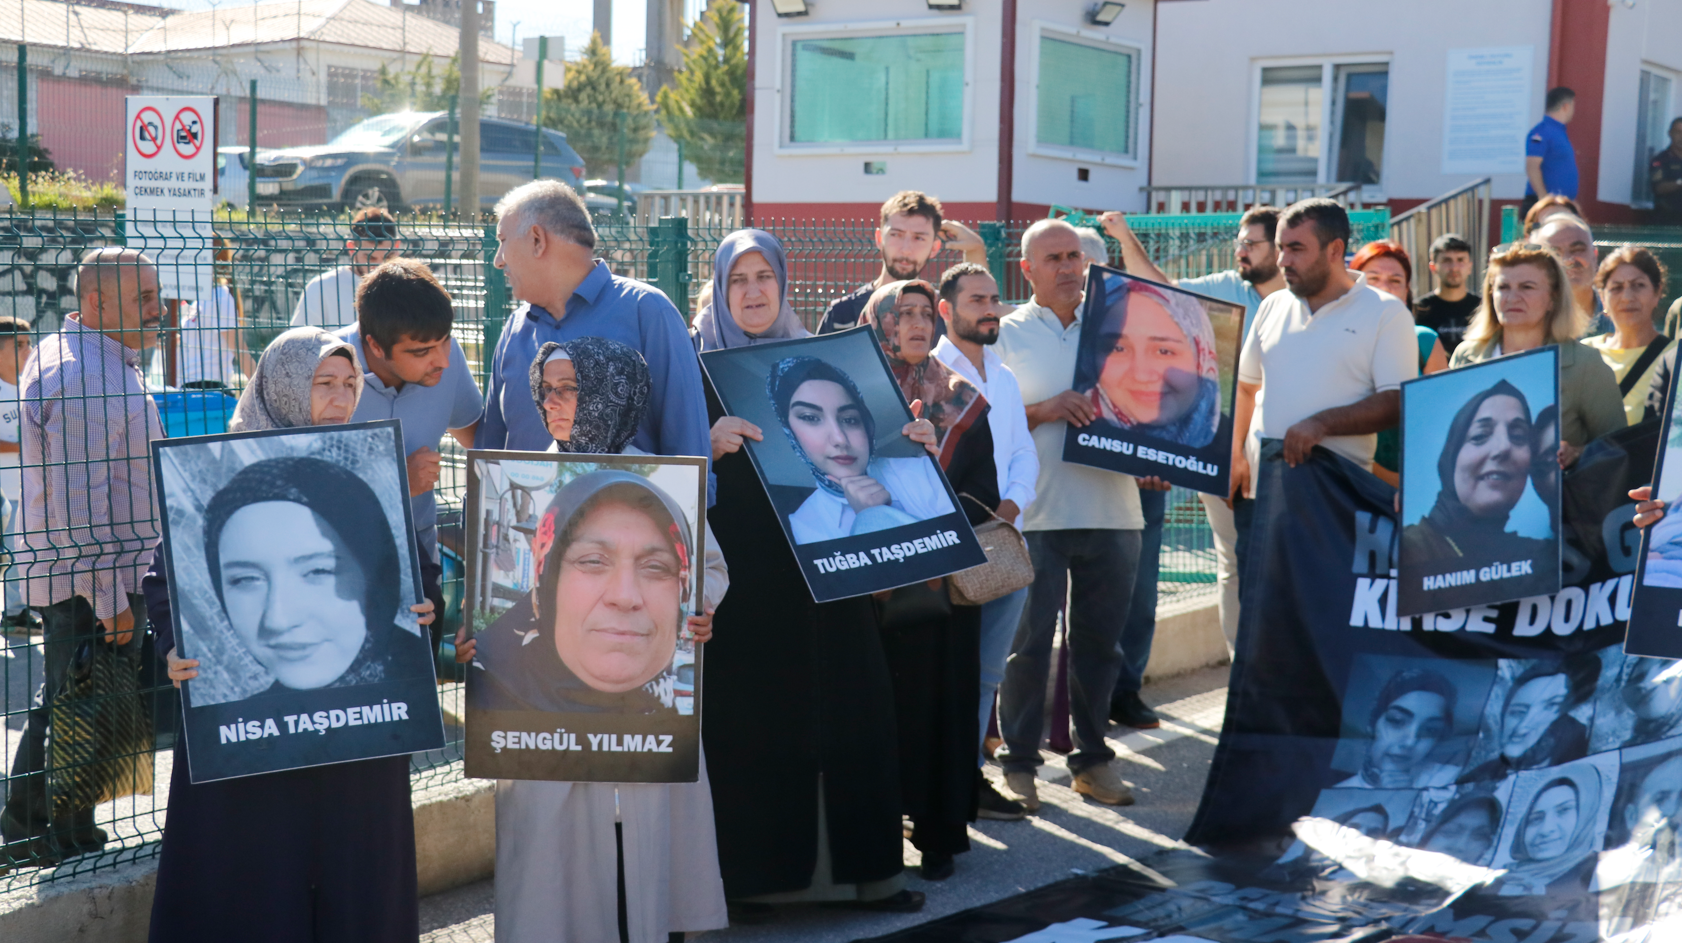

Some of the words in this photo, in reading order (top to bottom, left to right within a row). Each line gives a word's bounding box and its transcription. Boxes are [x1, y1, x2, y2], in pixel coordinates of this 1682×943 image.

[134, 168, 173, 181] FOTOĞRAF
[176, 172, 185, 182] VE
[188, 169, 206, 182] FİLM
[134, 186, 165, 199] ÇEKMEK
[168, 188, 206, 198] YASAKTIR
[1077, 433, 1134, 455] CANSU
[1136, 445, 1219, 477] ESETOĞLU
[813, 551, 872, 574] TUĞBA
[870, 529, 961, 563] TAŞDEMİR
[1422, 569, 1476, 591] HANIM
[1479, 559, 1533, 582] GÜLEK
[219, 717, 280, 744] NİSA
[283, 699, 409, 735] TAŞDEMİR
[490, 728, 582, 753] ŞENGÜL
[587, 733, 673, 752] YILMAZ
